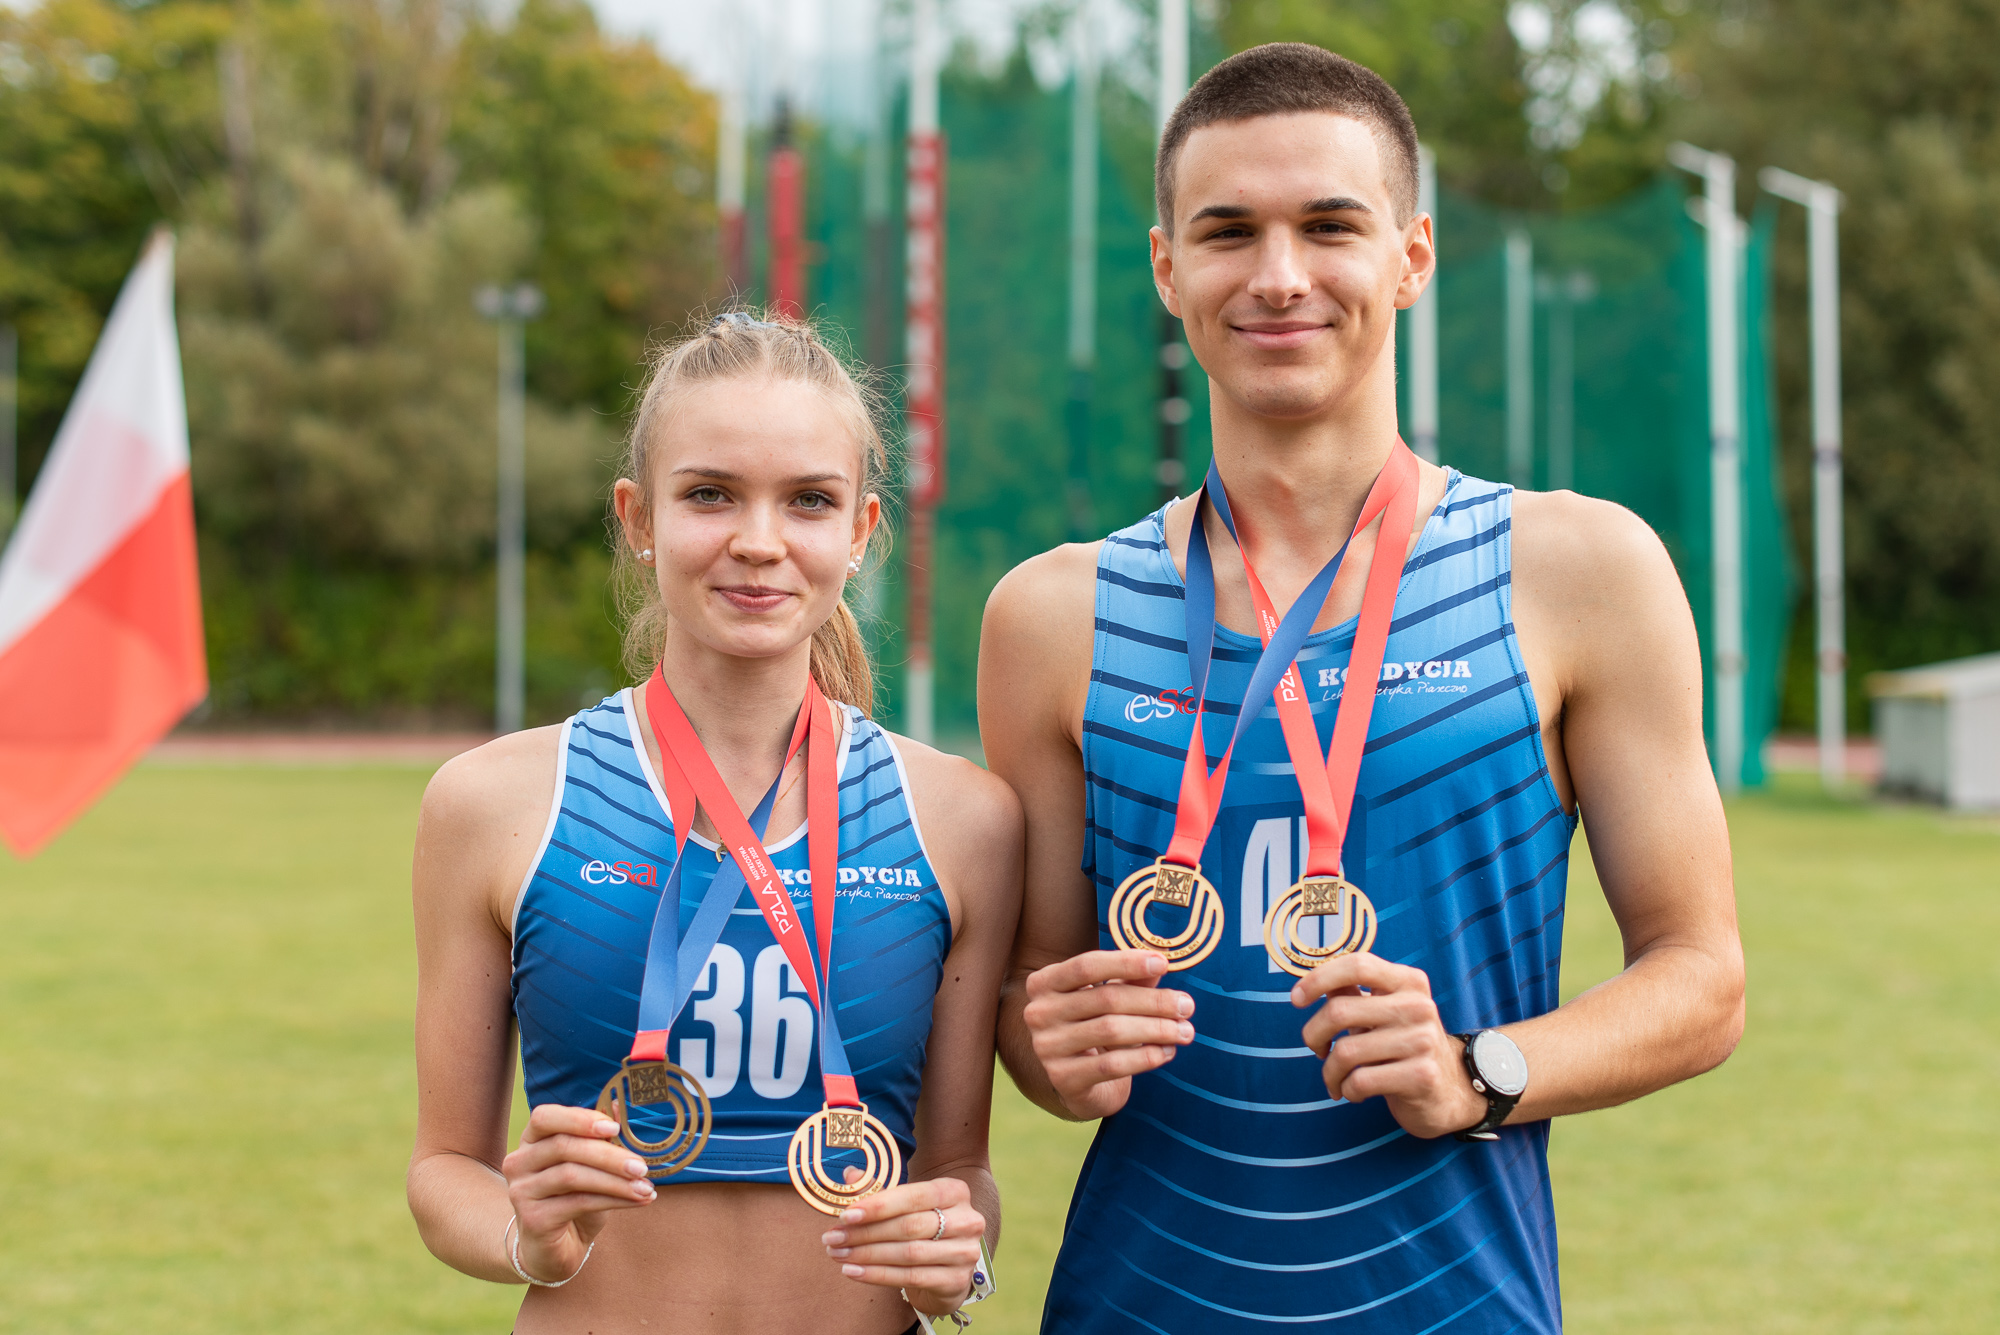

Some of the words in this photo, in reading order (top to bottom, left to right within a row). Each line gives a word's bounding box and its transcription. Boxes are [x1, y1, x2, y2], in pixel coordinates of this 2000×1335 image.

[1280, 667, 1299, 702] PZL
[1318, 660, 1472, 687] KDYCJA
[738, 845, 761, 881] MISTRZOSTWA
[754, 858, 768, 877] POLSKI
[776, 866, 922, 887] KODYCJA
[762, 880, 793, 935] PZLA
[1304, 900, 1336, 913] PZLA
[679, 942, 814, 1100] 36
[829, 1132, 861, 1147] PZLA
[833, 1182, 855, 1191] PZLA
